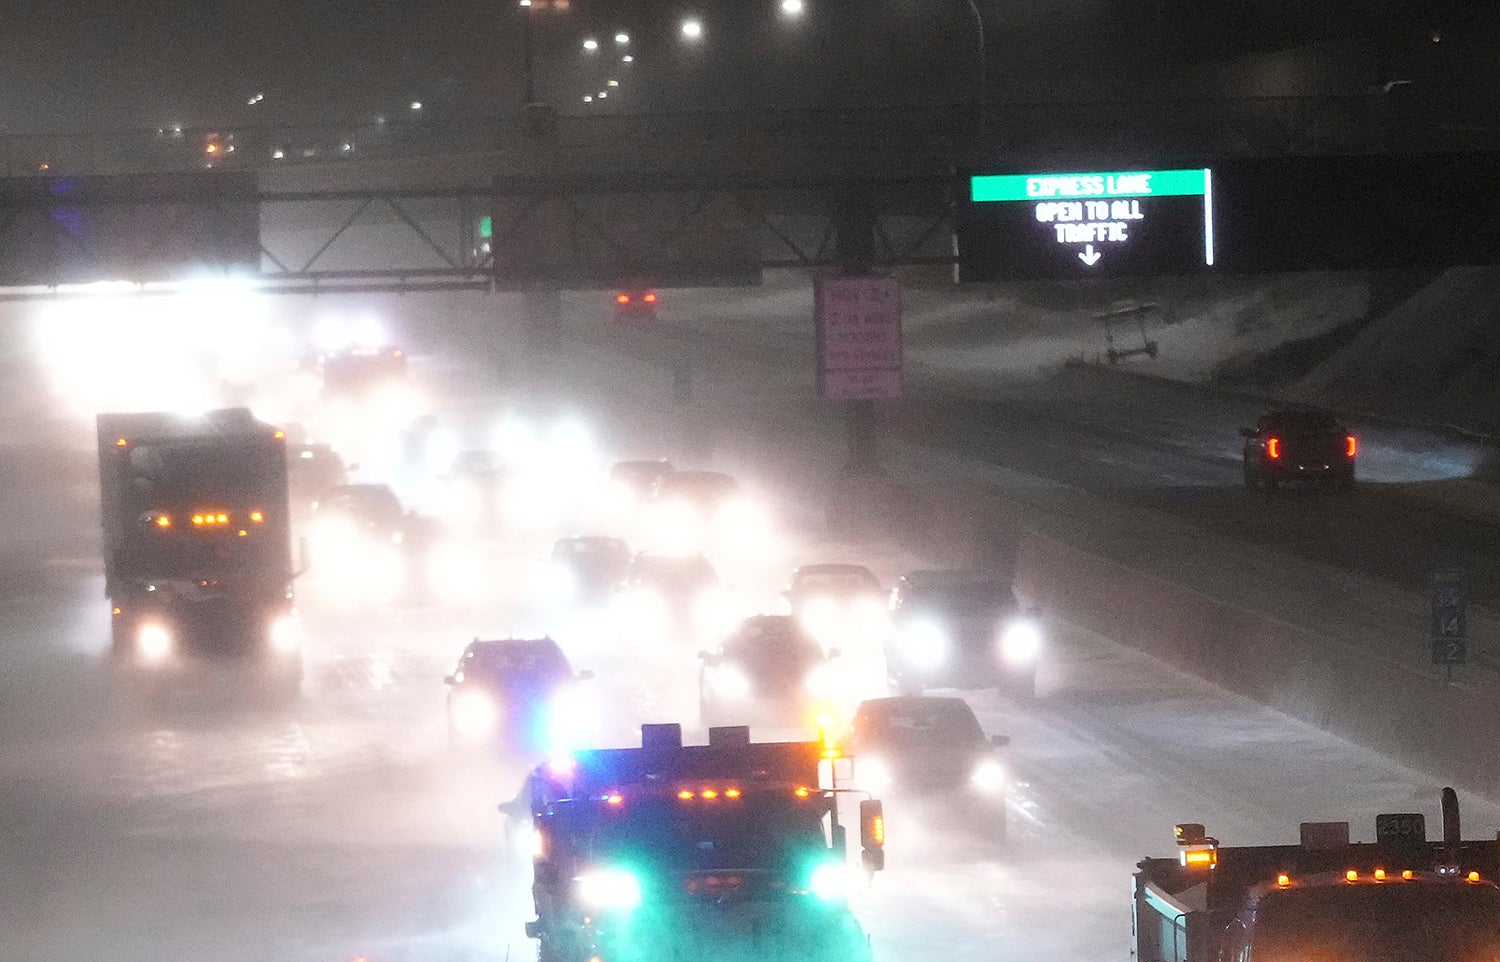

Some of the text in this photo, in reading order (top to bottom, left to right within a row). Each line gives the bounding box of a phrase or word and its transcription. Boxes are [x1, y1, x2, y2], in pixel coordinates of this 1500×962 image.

[1026, 174, 1152, 197] EXPRESS LANE
[1035, 200, 1144, 222] OPEN TO ALL
[1054, 222, 1128, 243] TRAFFIC
